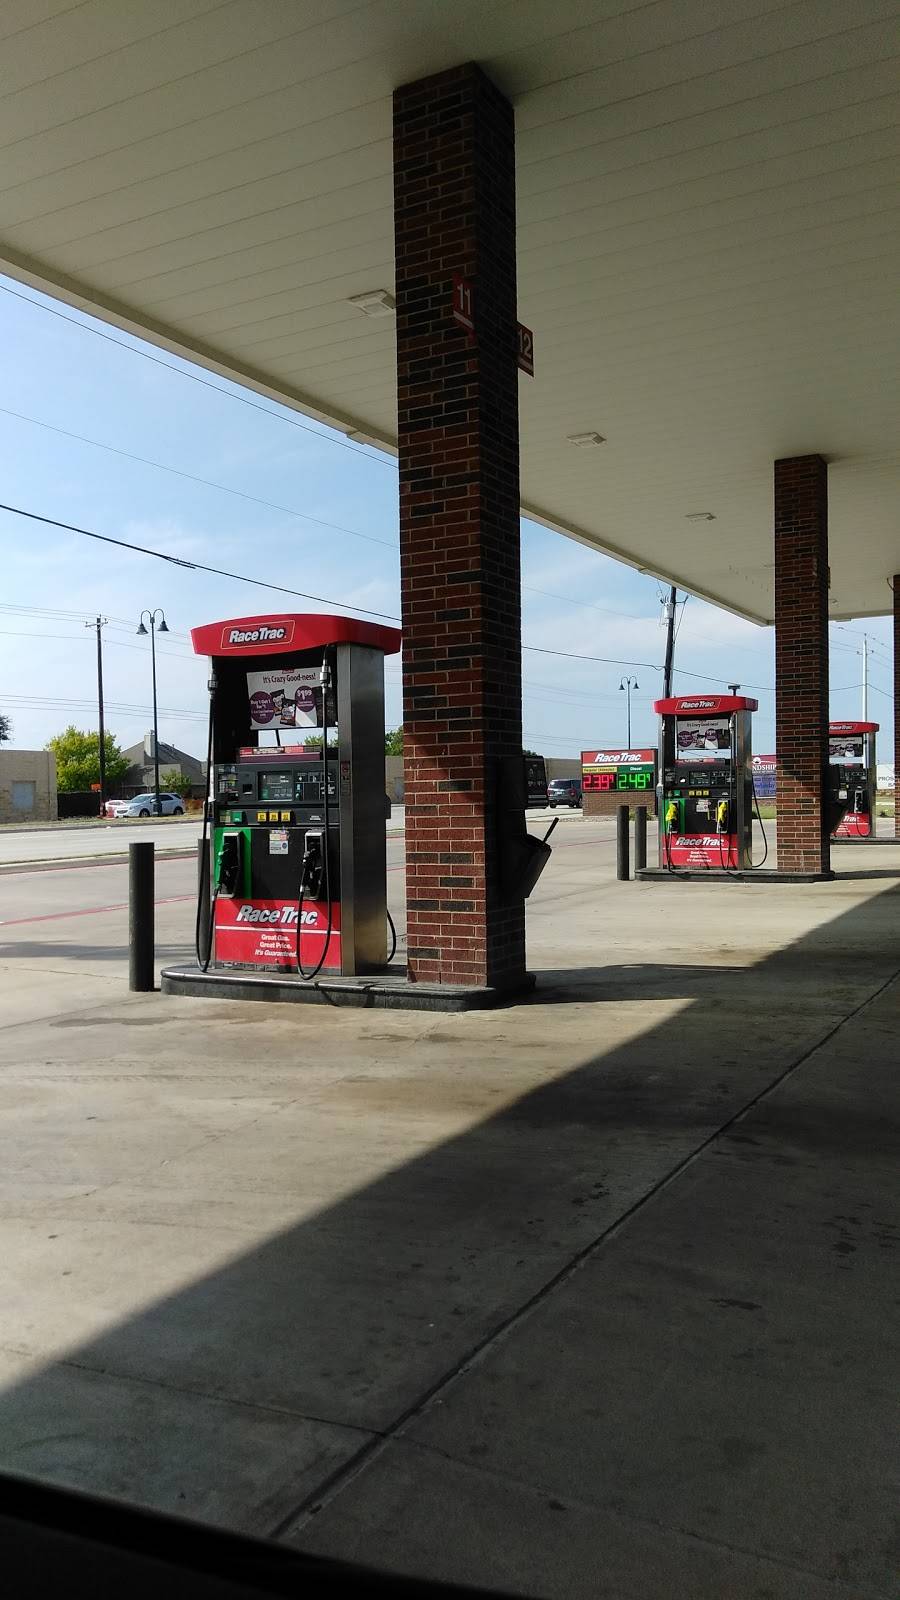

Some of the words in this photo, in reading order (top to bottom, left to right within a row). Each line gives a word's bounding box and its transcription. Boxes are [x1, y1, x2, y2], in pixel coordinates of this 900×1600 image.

[457, 283, 471, 315] 11
[518, 328, 532, 360] 12
[229, 627, 285, 643] RaceTrac
[263, 676, 271, 684] It's
[271, 675, 286, 684] Crazy
[681, 700, 715, 709] RaceTrac
[595, 752, 641, 762] RaceTrac
[675, 837, 724, 846] RaceTrac
[236, 905, 318, 925] RaceTrac
[255, 949, 263, 957] It's
